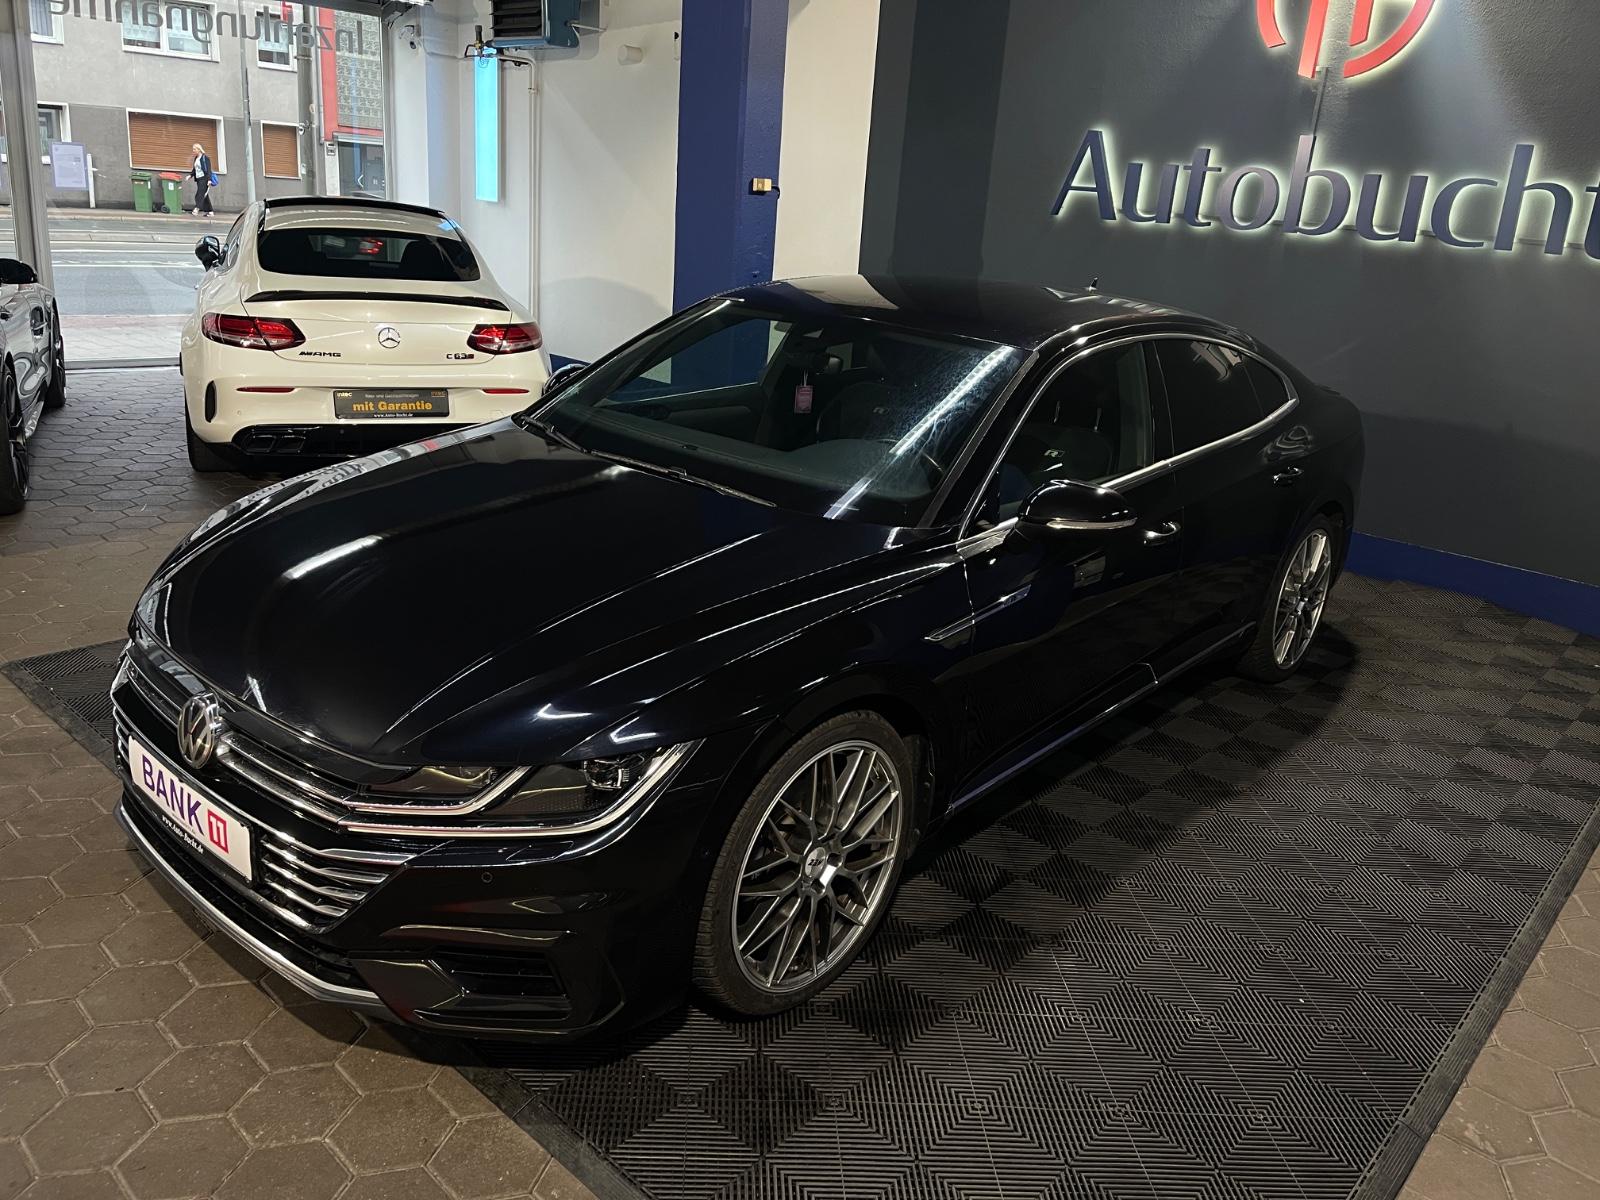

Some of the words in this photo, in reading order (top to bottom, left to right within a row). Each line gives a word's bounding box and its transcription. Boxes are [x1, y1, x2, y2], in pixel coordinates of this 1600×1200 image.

[352, 401, 375, 411] mit
[378, 400, 433, 411] Garantie
[142, 753, 205, 836] BANK
[209, 811, 228, 852] 11
